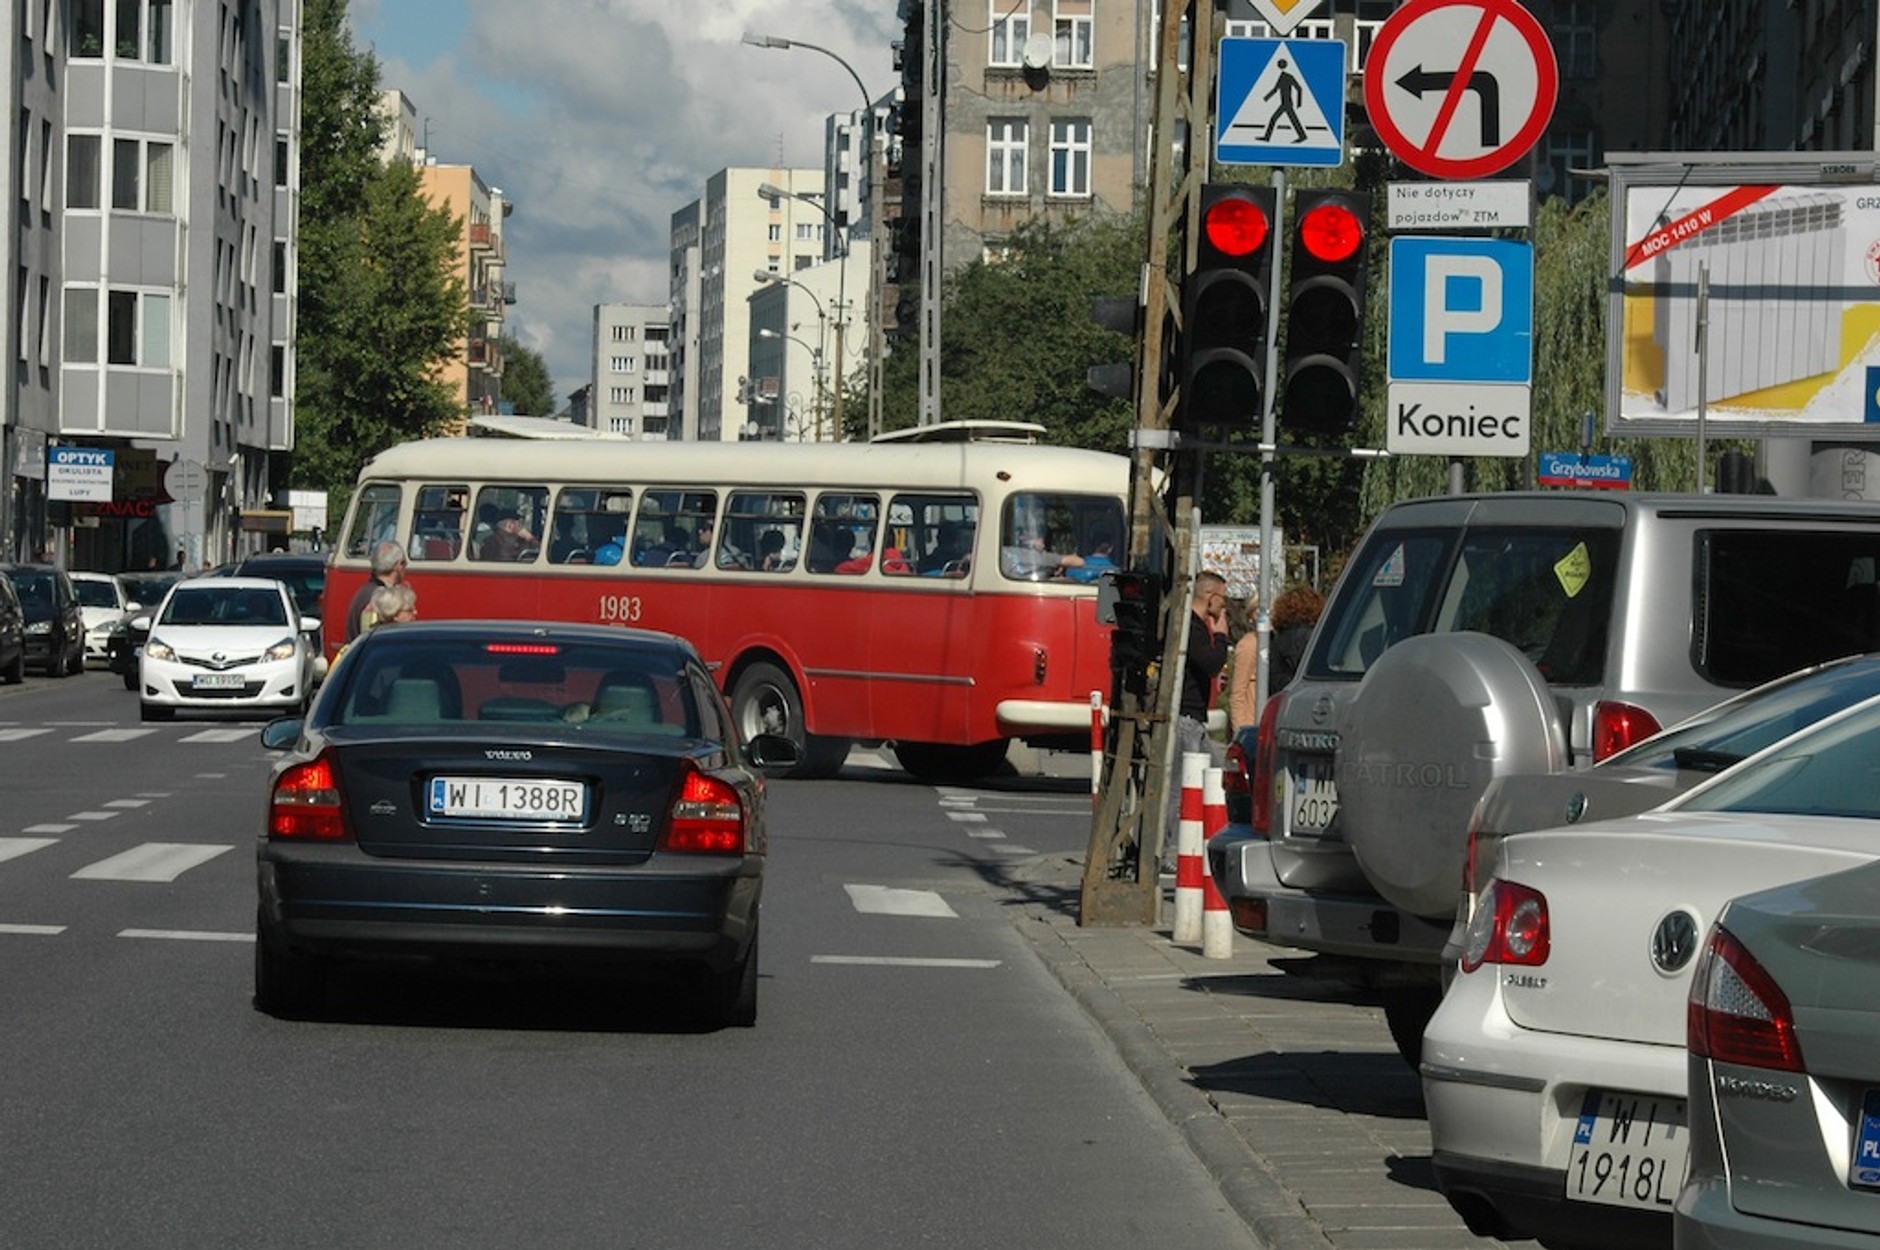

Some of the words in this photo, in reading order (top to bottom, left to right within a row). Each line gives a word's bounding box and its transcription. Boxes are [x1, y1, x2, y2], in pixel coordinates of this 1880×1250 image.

[1396, 187, 1419, 199] Nie
[1424, 187, 1476, 200] dotyczy
[1473, 210, 1500, 223] ZTM
[1641, 234, 1670, 257] MOC
[1671, 219, 1699, 242] 1410
[1698, 209, 1713, 225] W
[1423, 254, 1503, 364] P
[1398, 404, 1521, 438] Koniec
[57, 451, 107, 465] OPTYK
[1549, 460, 1620, 479] Grzybowska
[600, 595, 641, 621] 1983
[485, 751, 532, 760] VOLVO
[1342, 762, 1471, 790] PATROL
[449, 783, 481, 808] WI
[499, 784, 578, 813] 1388R
[1609, 1098, 1658, 1147] WI
[1863, 1139, 1880, 1159] PL
[1578, 1150, 1673, 1205] 1918L
